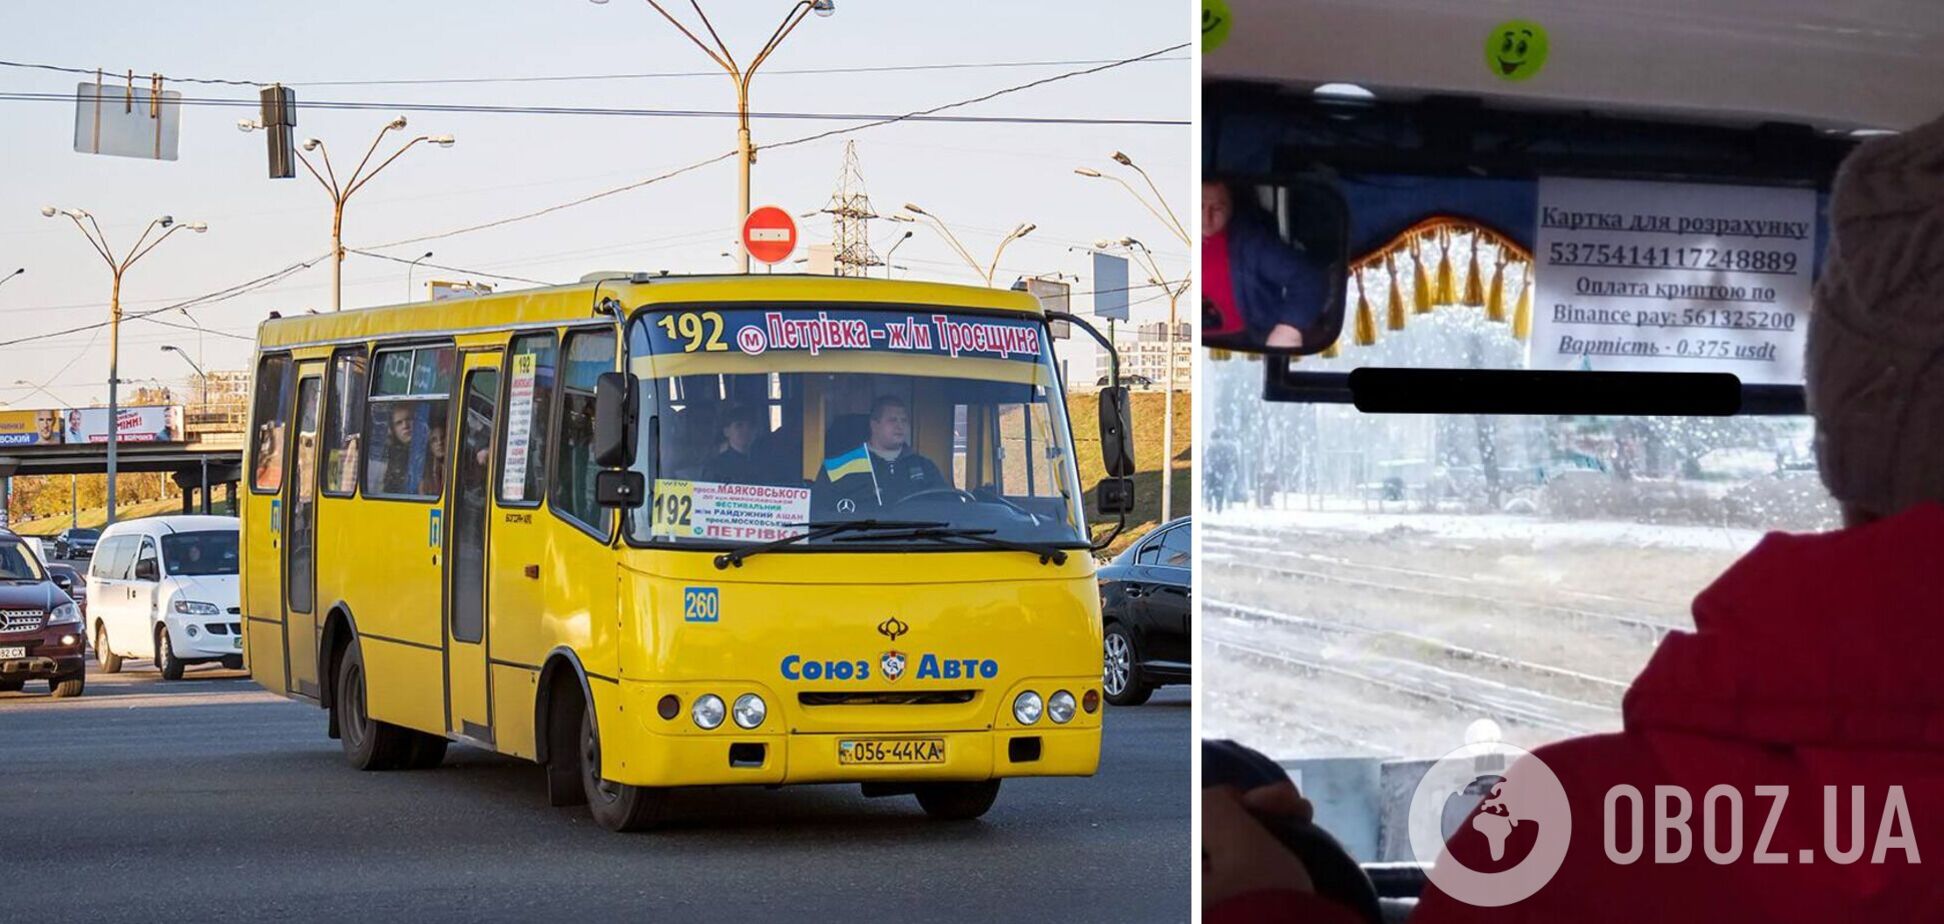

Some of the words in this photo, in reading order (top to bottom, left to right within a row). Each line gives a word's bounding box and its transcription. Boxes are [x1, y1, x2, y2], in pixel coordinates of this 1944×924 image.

[1541, 206, 1623, 230] Картка
[1630, 213, 1671, 231] для
[1678, 216, 1809, 240] розрахунку
[1549, 242, 1797, 272] 5375414117248889
[1576, 276, 1650, 295] Оплата
[1656, 282, 1746, 300] криптою
[1752, 286, 1776, 301] по
[1553, 303, 1632, 323] Binance
[1636, 309, 1678, 328] pay:
[1682, 308, 1796, 329] 561325200
[658, 312, 728, 352] 192
[766, 312, 871, 355] Петрівка
[886, 317, 932, 349] ж/м
[932, 314, 1041, 358] Троєщина
[1558, 335, 1660, 355] Вартість
[1676, 339, 1730, 358] 0.375
[1735, 341, 1777, 361] usdt
[654, 494, 692, 526] 192
[686, 592, 717, 618] 260
[780, 654, 870, 680] Союз
[916, 653, 999, 679] Авто
[854, 742, 940, 761] 056-44КА
